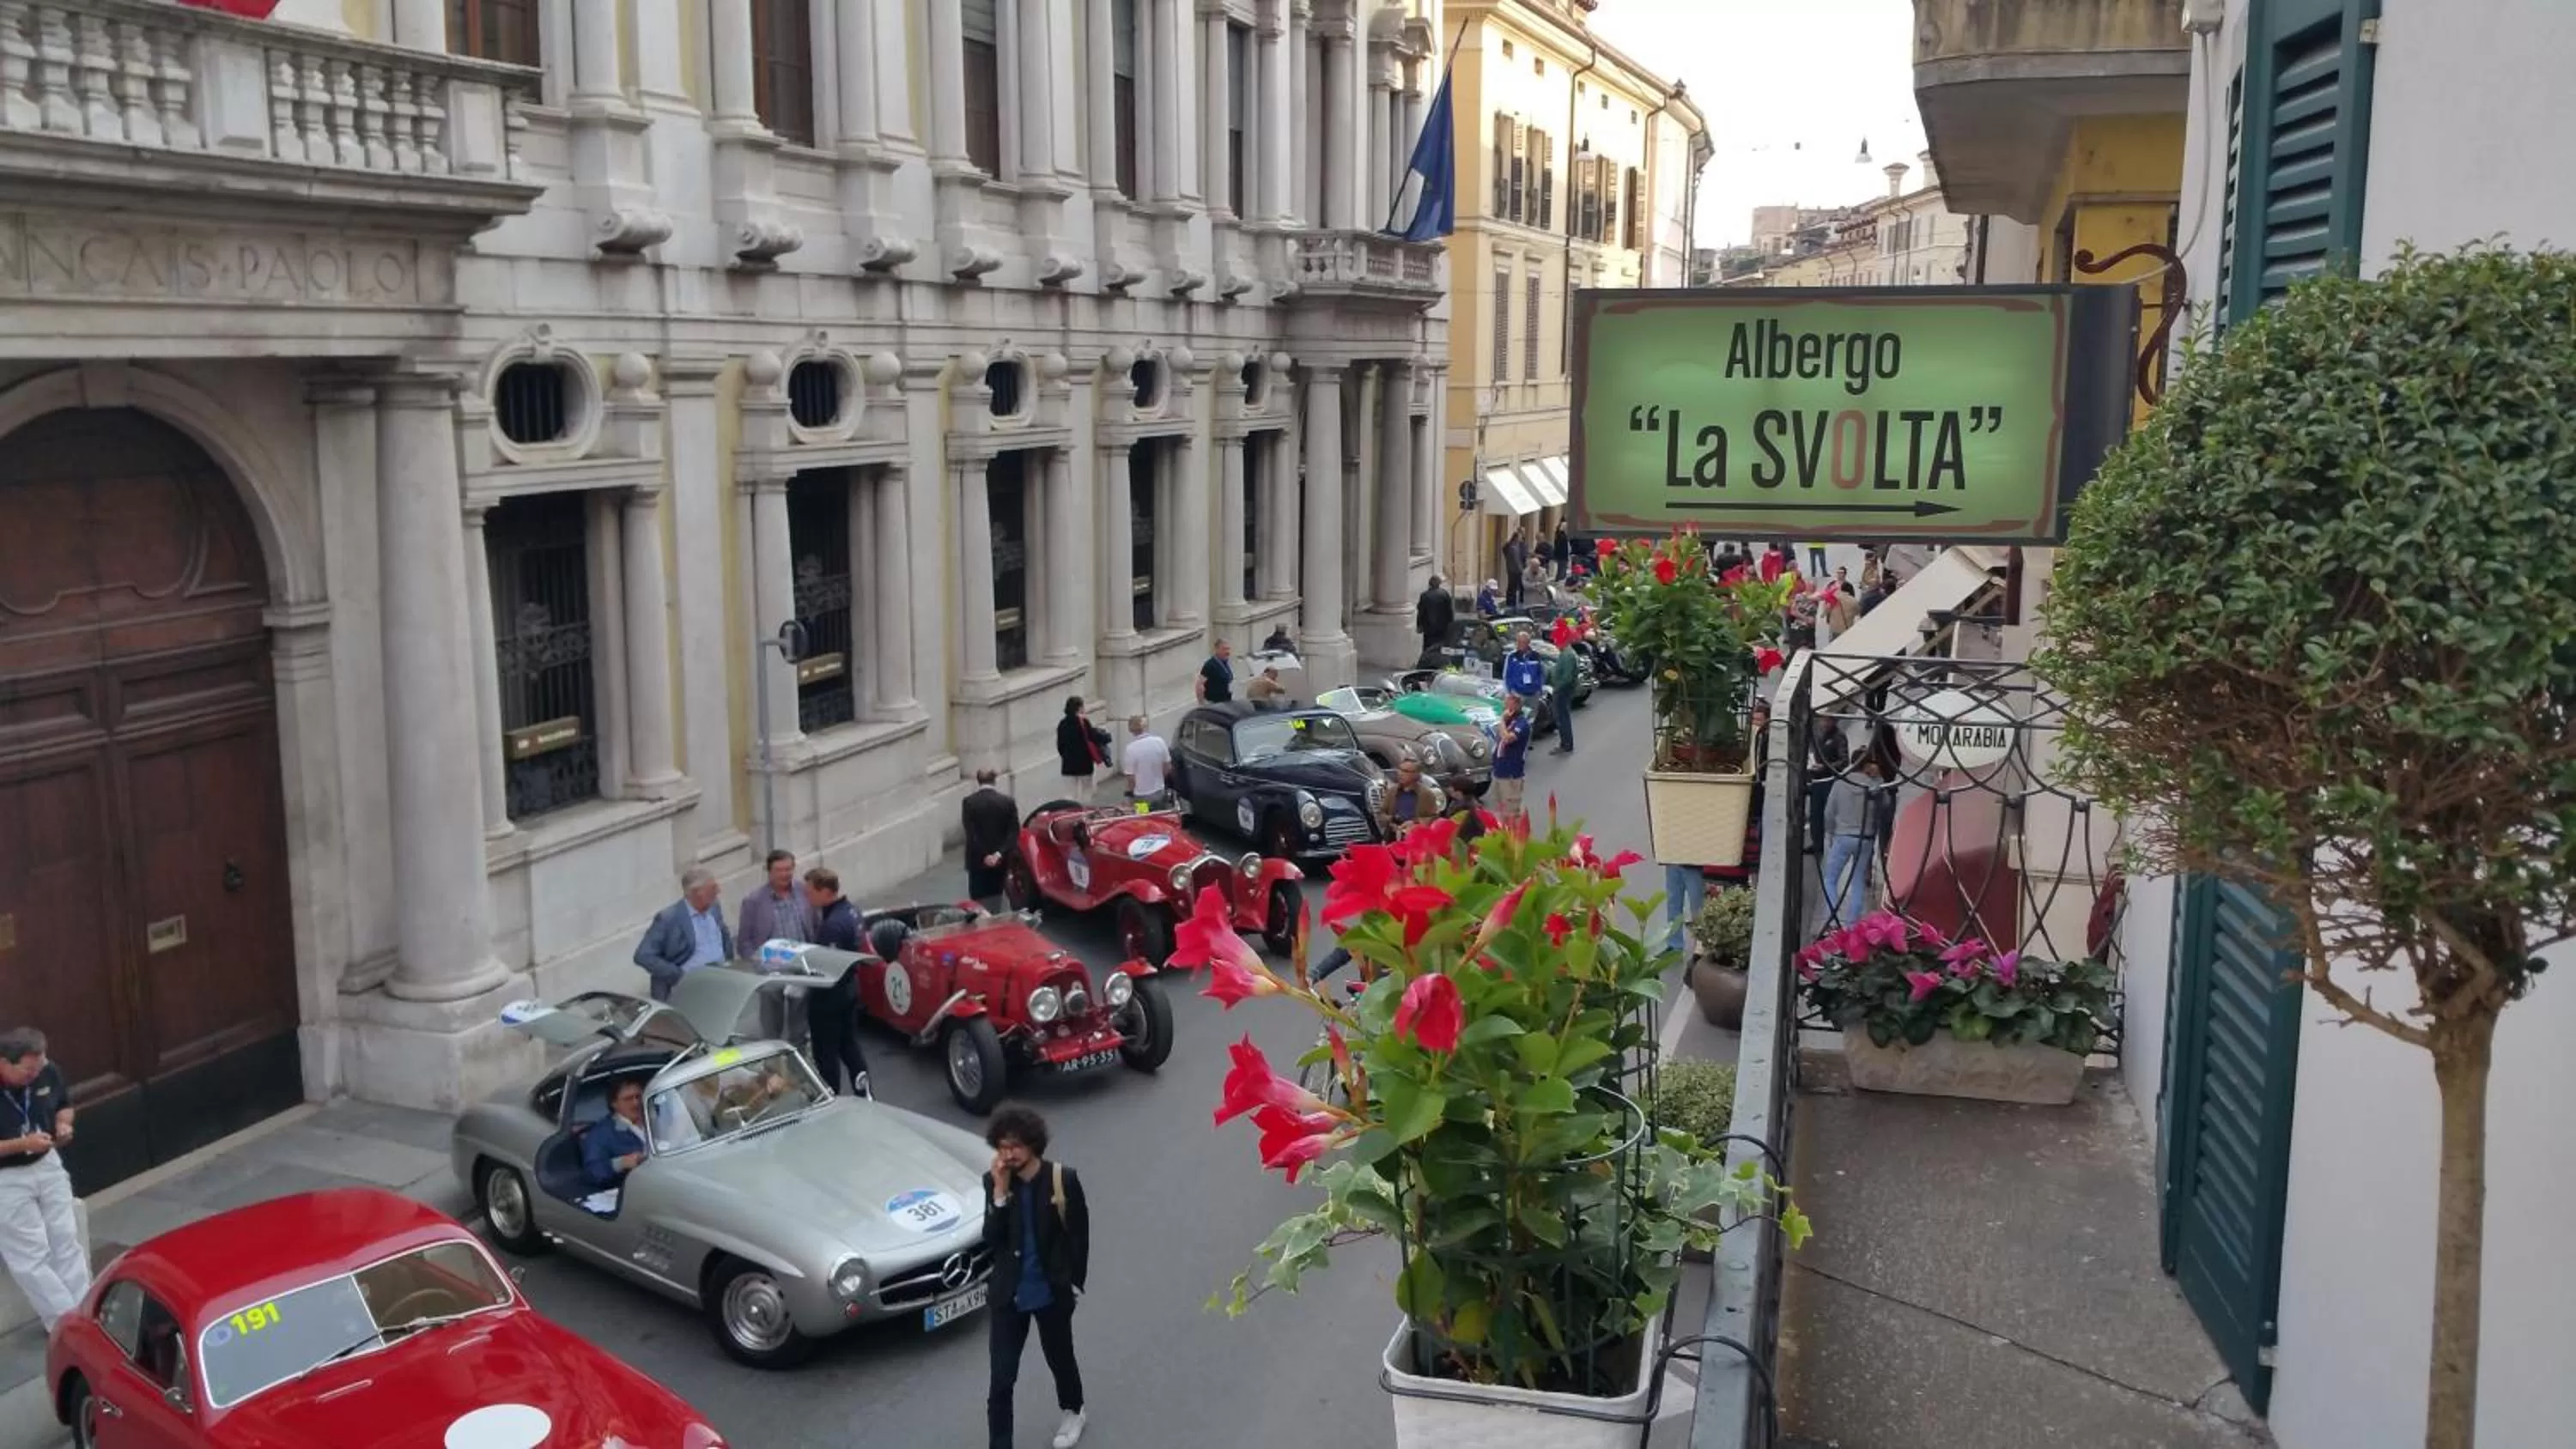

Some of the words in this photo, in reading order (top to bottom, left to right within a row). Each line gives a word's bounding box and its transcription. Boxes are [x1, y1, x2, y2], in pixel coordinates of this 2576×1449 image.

[1723, 318, 1902, 396] Albergo
[1917, 724, 2007, 749] MOARABIA
[906, 1199, 946, 1222] 381
[229, 1301, 282, 1337] 191
